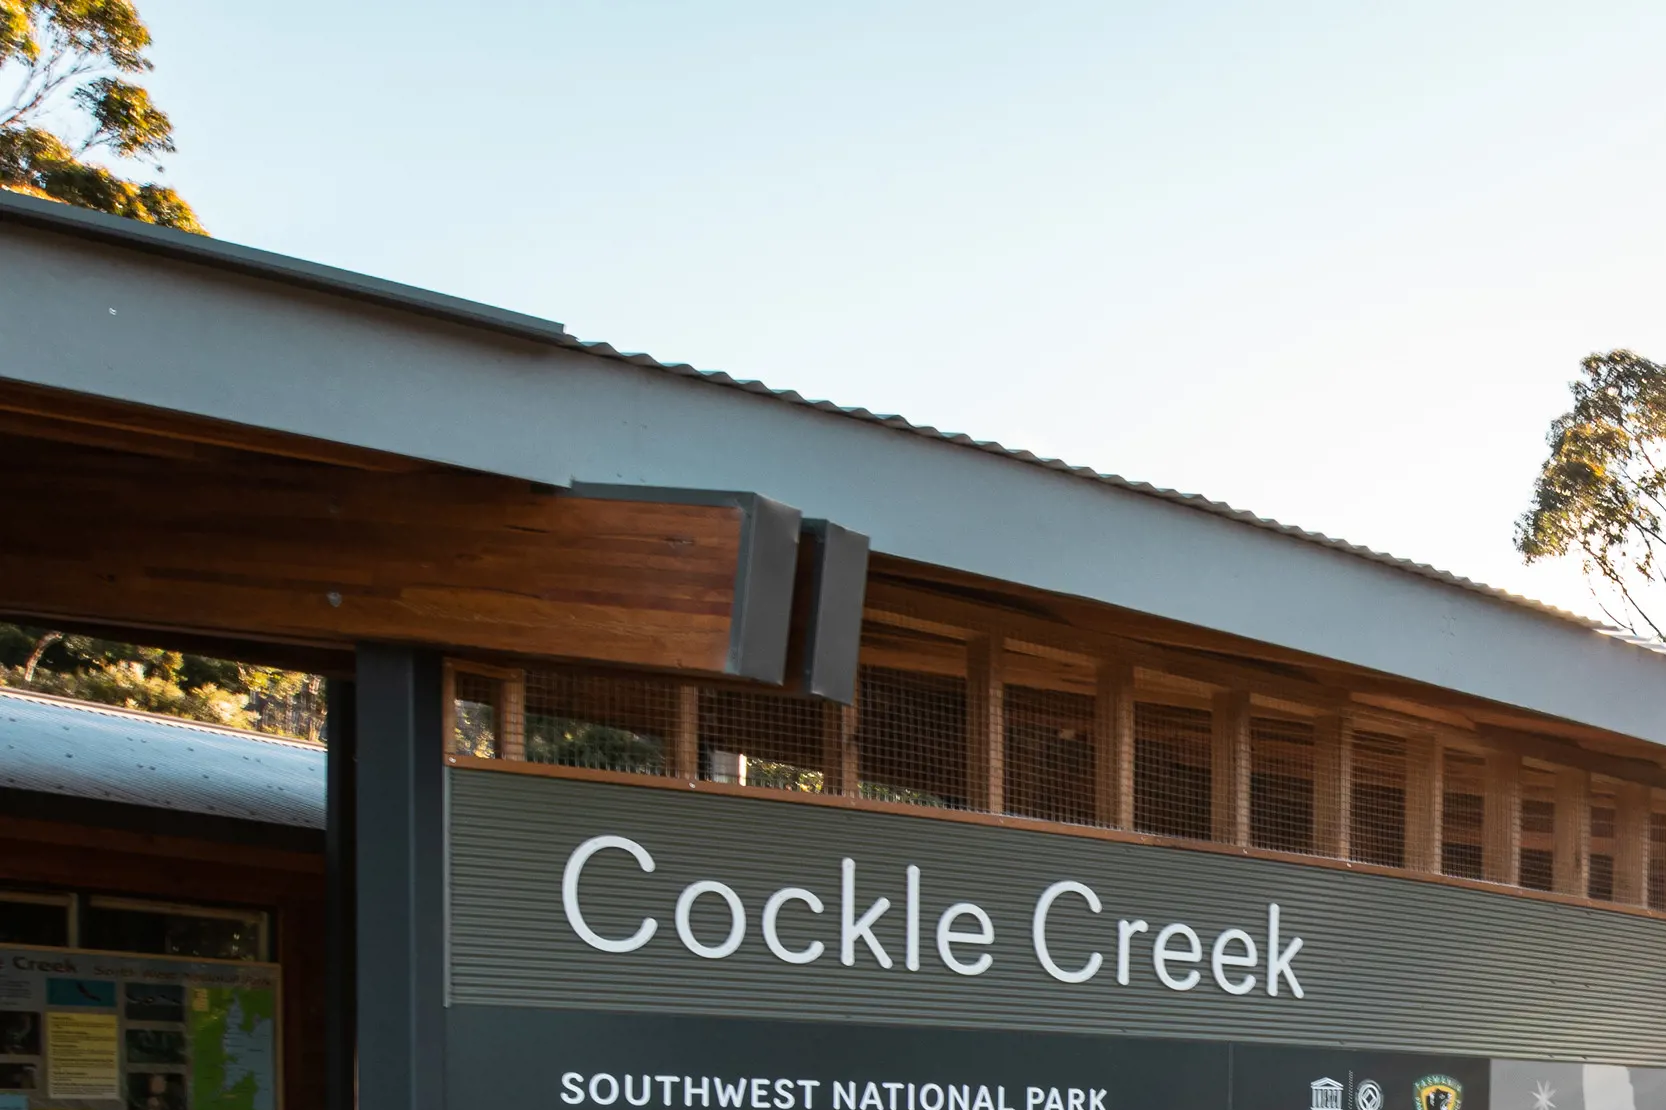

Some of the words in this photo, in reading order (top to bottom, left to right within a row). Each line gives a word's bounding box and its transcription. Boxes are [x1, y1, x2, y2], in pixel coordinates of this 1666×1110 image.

[562, 835, 995, 976] Cockle
[1033, 880, 1306, 999] Creek
[12, 956, 77, 973] Creek
[560, 1071, 821, 1110] SOUTHWEST
